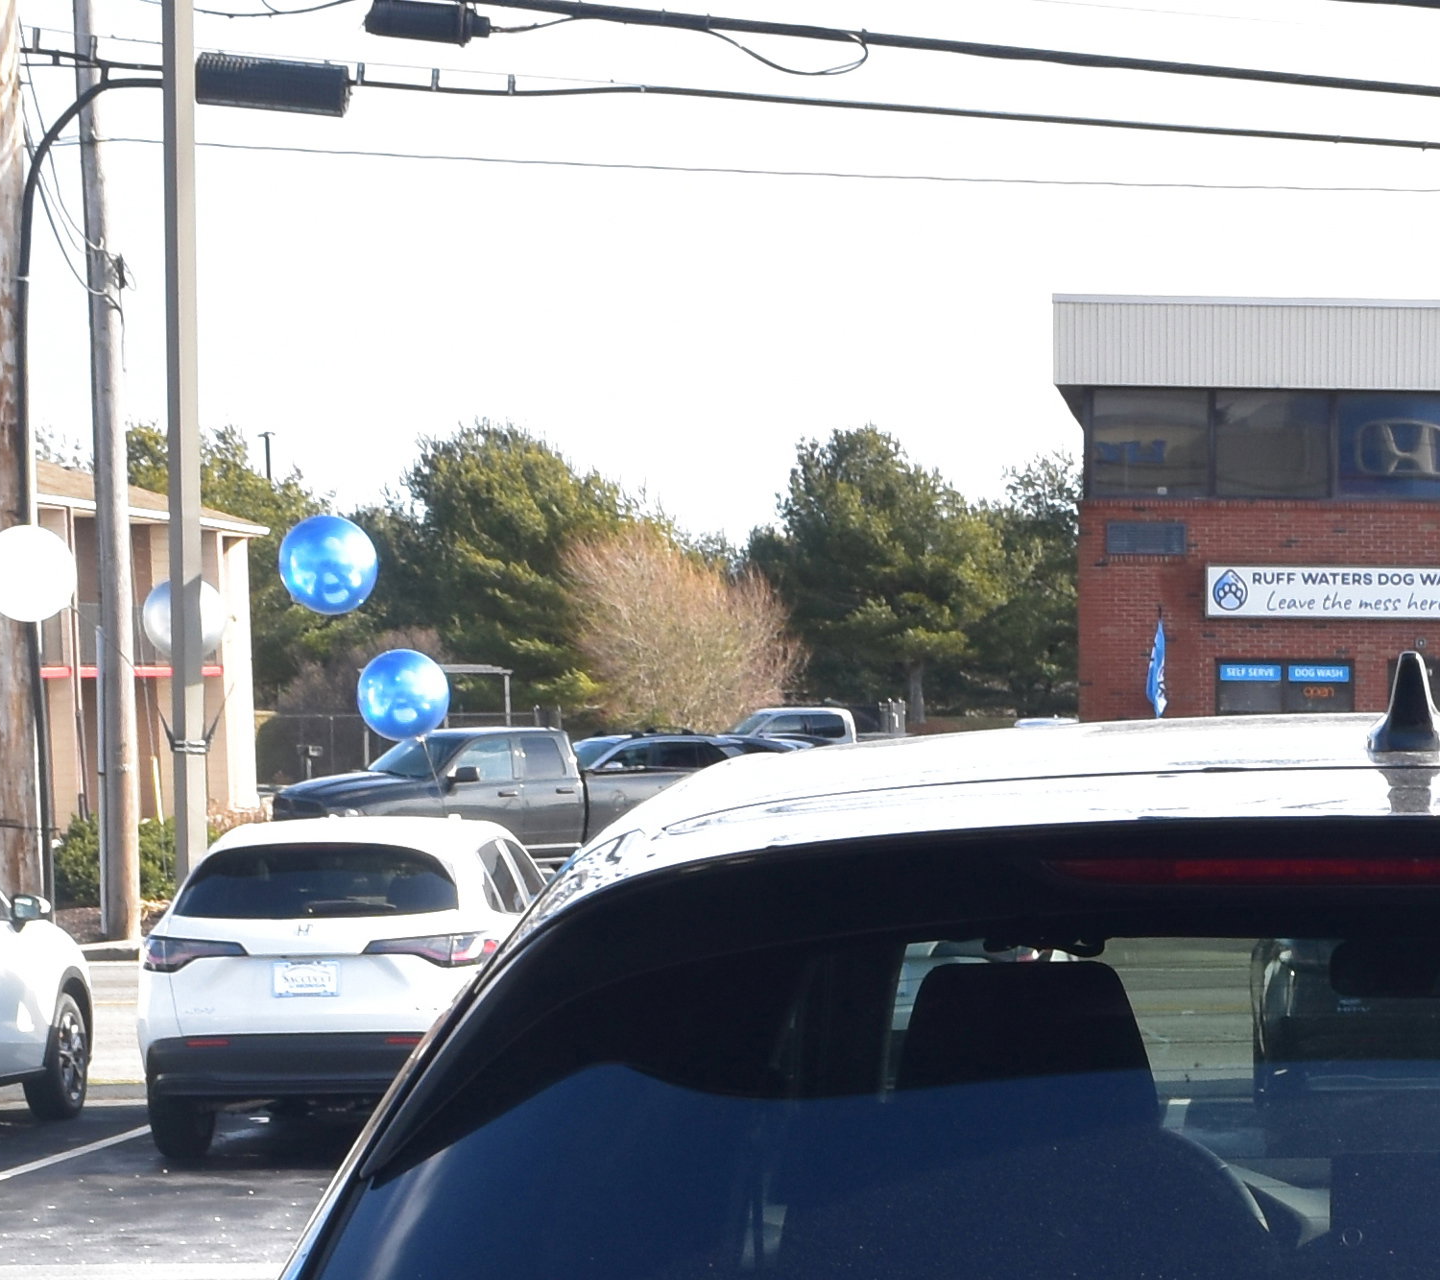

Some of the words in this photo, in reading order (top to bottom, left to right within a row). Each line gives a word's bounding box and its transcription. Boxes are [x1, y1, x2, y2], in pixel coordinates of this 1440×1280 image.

[1252, 572, 1295, 585] RUFF
[1301, 572, 1373, 586] WATERS
[1378, 573, 1415, 586] DOG
[1266, 591, 1317, 611] Leave
[1322, 592, 1352, 611] the
[1359, 598, 1402, 612] mess
[1226, 667, 1245, 678] SELF
[1248, 667, 1275, 678] SERVE
[1294, 668, 1311, 678] DOG
[1313, 668, 1344, 679] WASH
